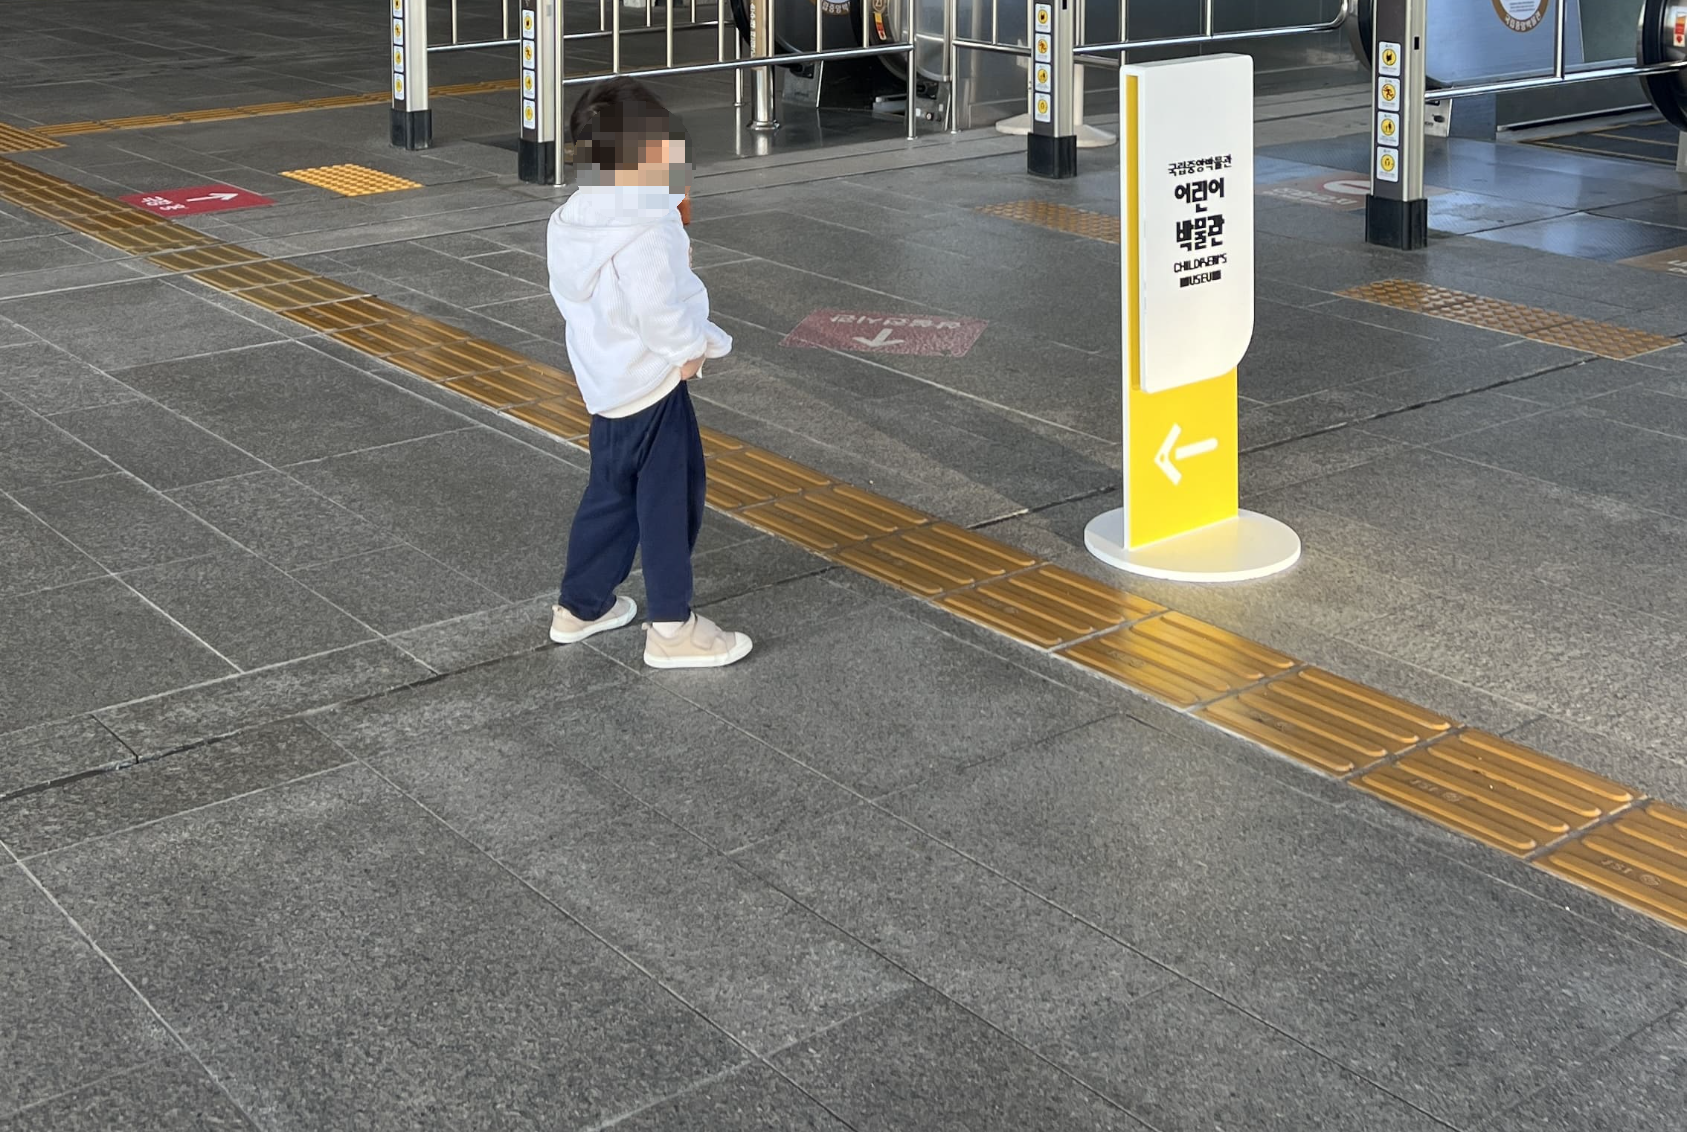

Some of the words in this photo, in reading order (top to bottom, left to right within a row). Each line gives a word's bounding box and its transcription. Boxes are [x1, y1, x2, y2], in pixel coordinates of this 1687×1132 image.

[1168, 154, 1232, 176] 국립중앙박물관
[1174, 177, 1224, 213] 어린이
[1176, 214, 1225, 251] 박물관
[1173, 253, 1227, 273] CHILDREN'S
[1180, 270, 1222, 288] MUSEUM
